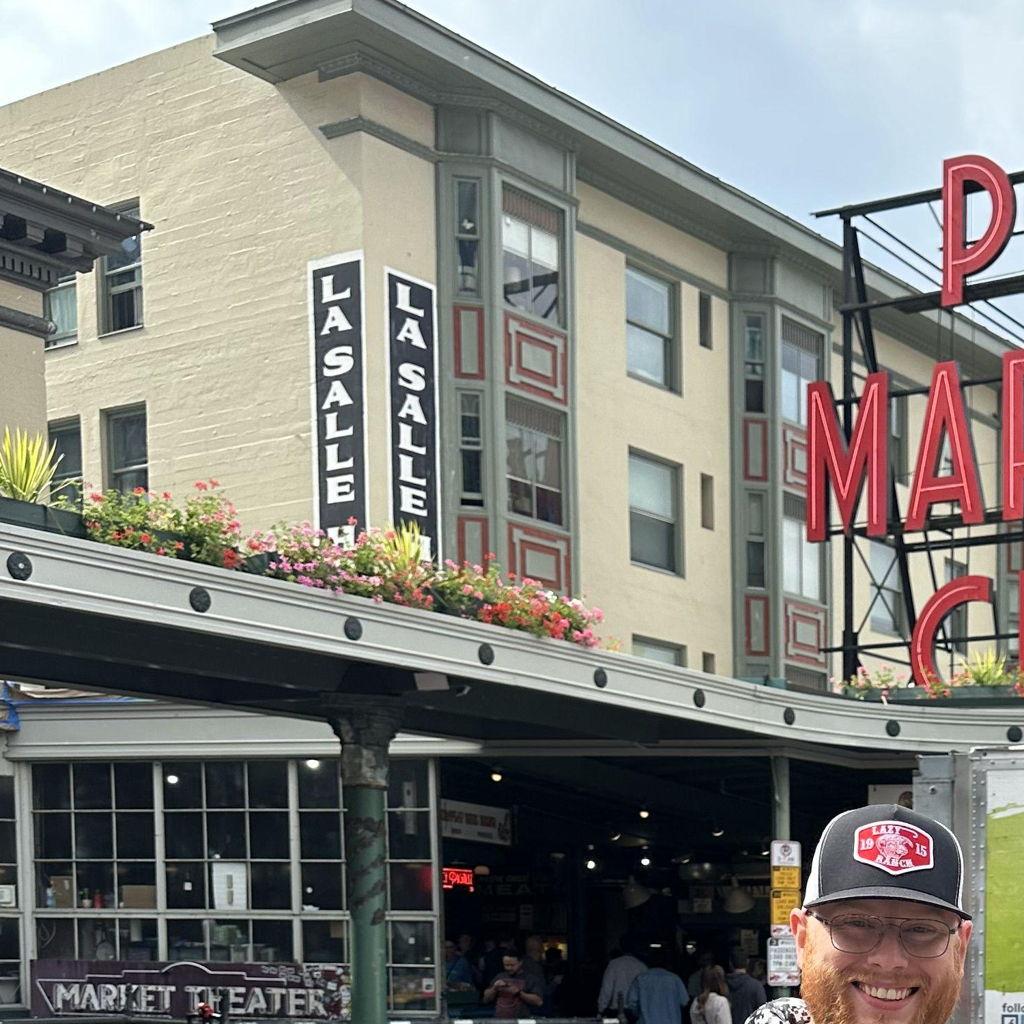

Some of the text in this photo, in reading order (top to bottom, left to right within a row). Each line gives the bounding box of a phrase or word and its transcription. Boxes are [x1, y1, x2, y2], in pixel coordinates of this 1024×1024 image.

[320, 274, 353, 336] LA
[396, 282, 427, 350] LA
[321, 345, 355, 504] SALLE
[397, 362, 428, 517] SALLE
[859, 838, 874, 850] 19
[872, 824, 900, 835] LAZY
[875, 855, 913, 867] RANCH
[915, 843, 928, 857] 15
[53, 983, 328, 1017] MARKET THEATER
